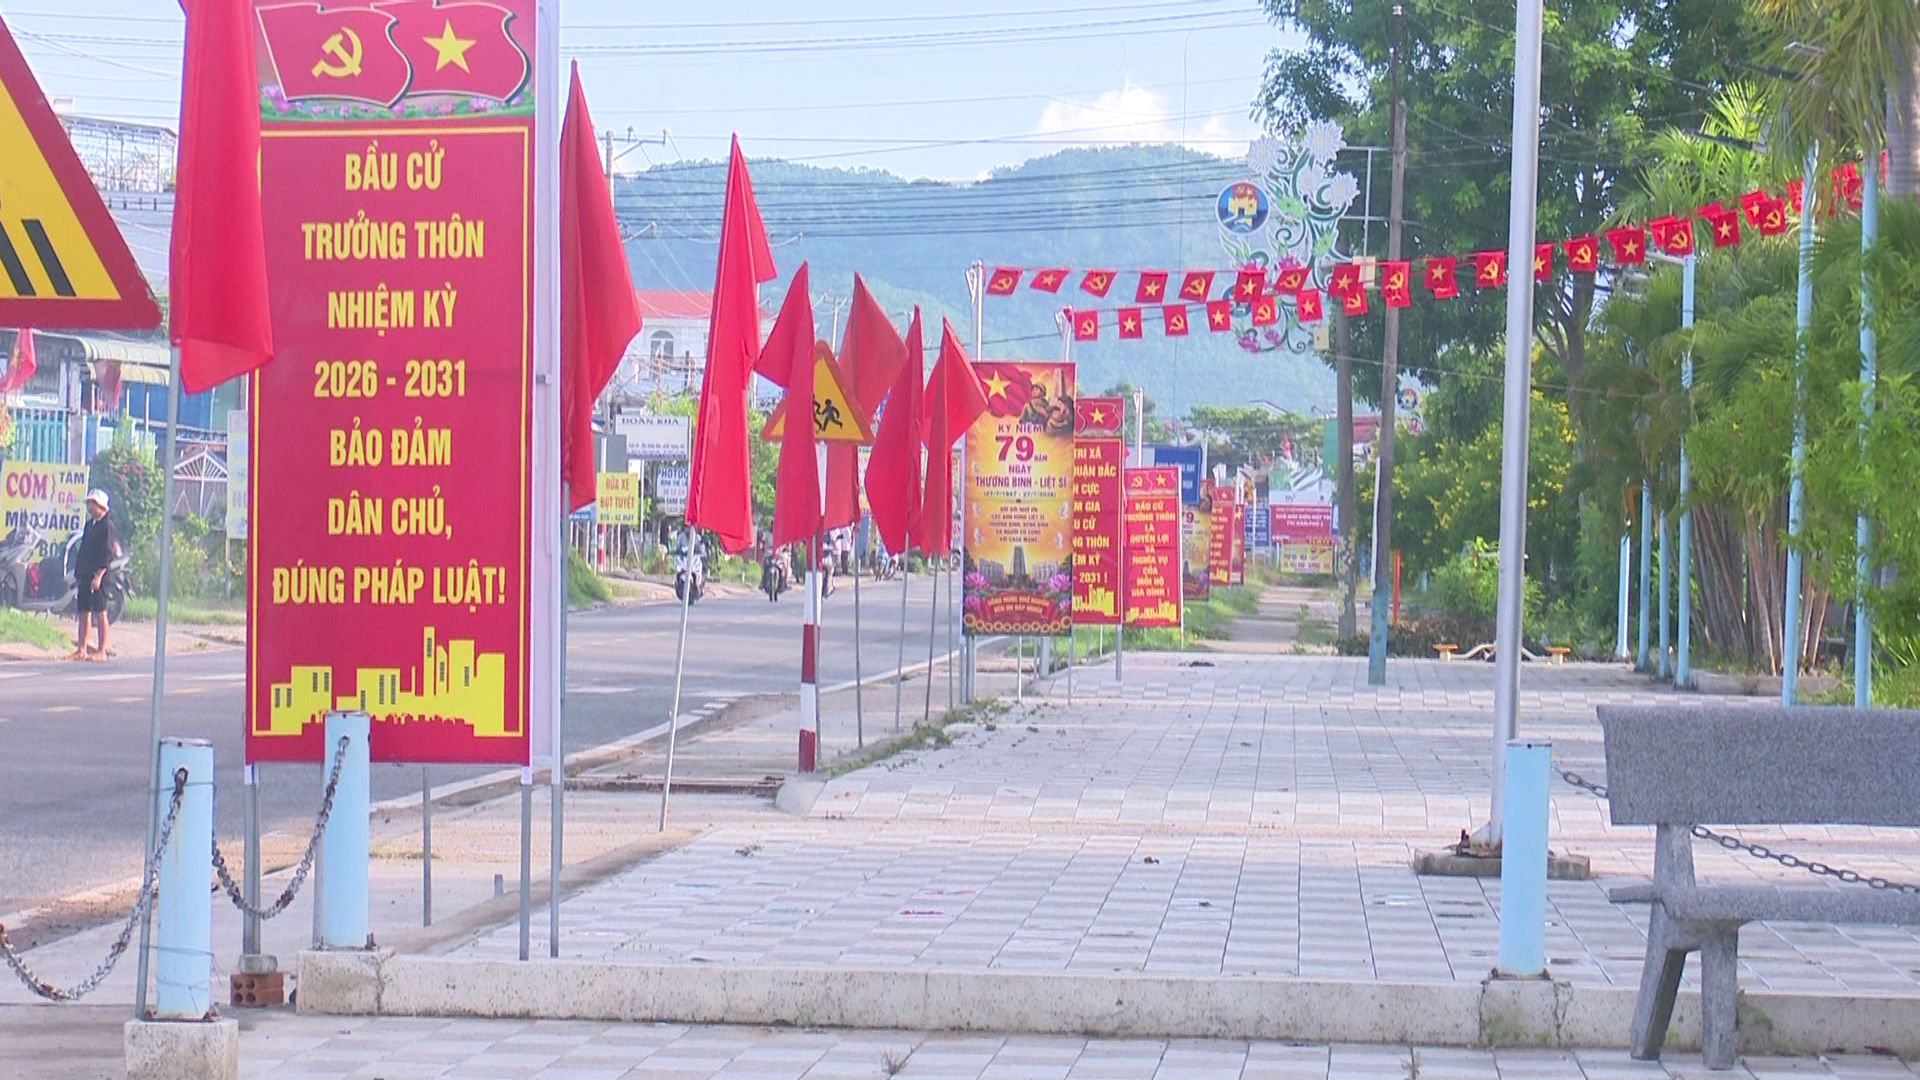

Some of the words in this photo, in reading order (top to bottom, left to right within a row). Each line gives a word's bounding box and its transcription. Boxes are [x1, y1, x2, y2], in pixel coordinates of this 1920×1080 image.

[345, 139, 397, 191] BẦU
[406, 139, 446, 191] CỬ
[301, 209, 407, 260] TRƯỞNG
[414, 212, 485, 259] THÔN
[328, 282, 415, 337] NHIỆM
[423, 282, 457, 328] KỲ
[314, 360, 378, 397] 2026
[386, 376, 397, 386] -
[404, 359, 466, 397] 2031
[330, 416, 383, 466] BẢO
[390, 416, 452, 466] ĐẢM
[995, 435, 1034, 462] 79
[975, 475, 1010, 487] THƯƠNG
[1012, 476, 1032, 487] BINH
[1040, 475, 1056, 489] LIỆT
[1008, 463, 1032, 474] NGÀY
[6, 468, 48, 499] CƠM
[1081, 482, 1100, 498] CỰC
[328, 490, 383, 535] DÂN
[391, 485, 453, 540] CHỦ,
[1085, 501, 1100, 512] GIA
[1086, 534, 1110, 548] THÔN
[1089, 551, 1100, 565] KỲ
[272, 558, 345, 604] ĐÚNG
[353, 558, 424, 604] PHÁP
[433, 558, 506, 613] LUẬT!
[1079, 572, 1100, 584] 2031
